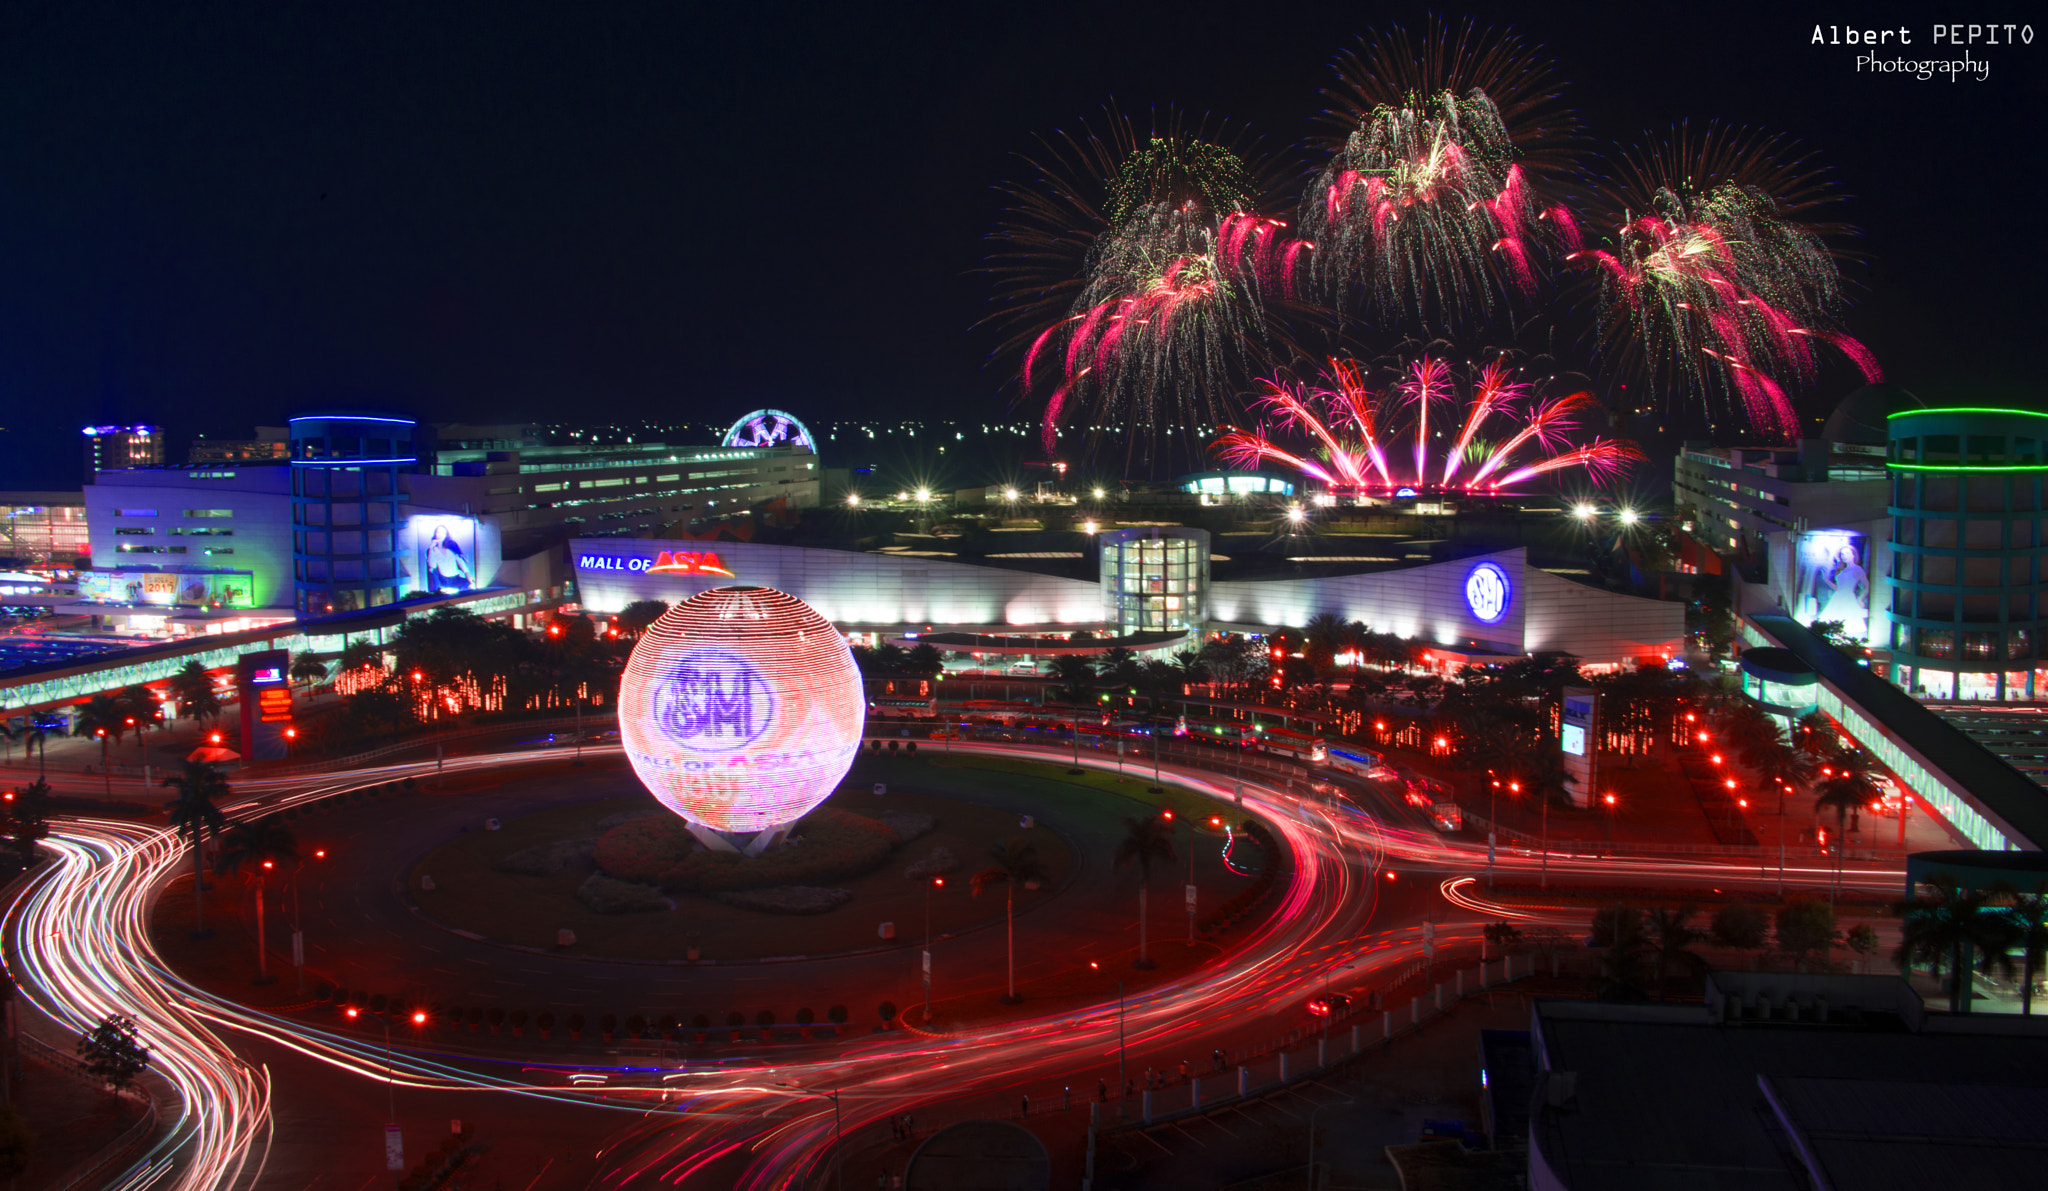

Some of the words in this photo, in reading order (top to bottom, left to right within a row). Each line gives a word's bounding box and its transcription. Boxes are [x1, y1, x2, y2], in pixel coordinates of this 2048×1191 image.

[580, 556, 624, 570] MALL
[628, 558, 652, 571] OF
[650, 551, 732, 576] ASIA
[148, 582, 174, 594] 2017
